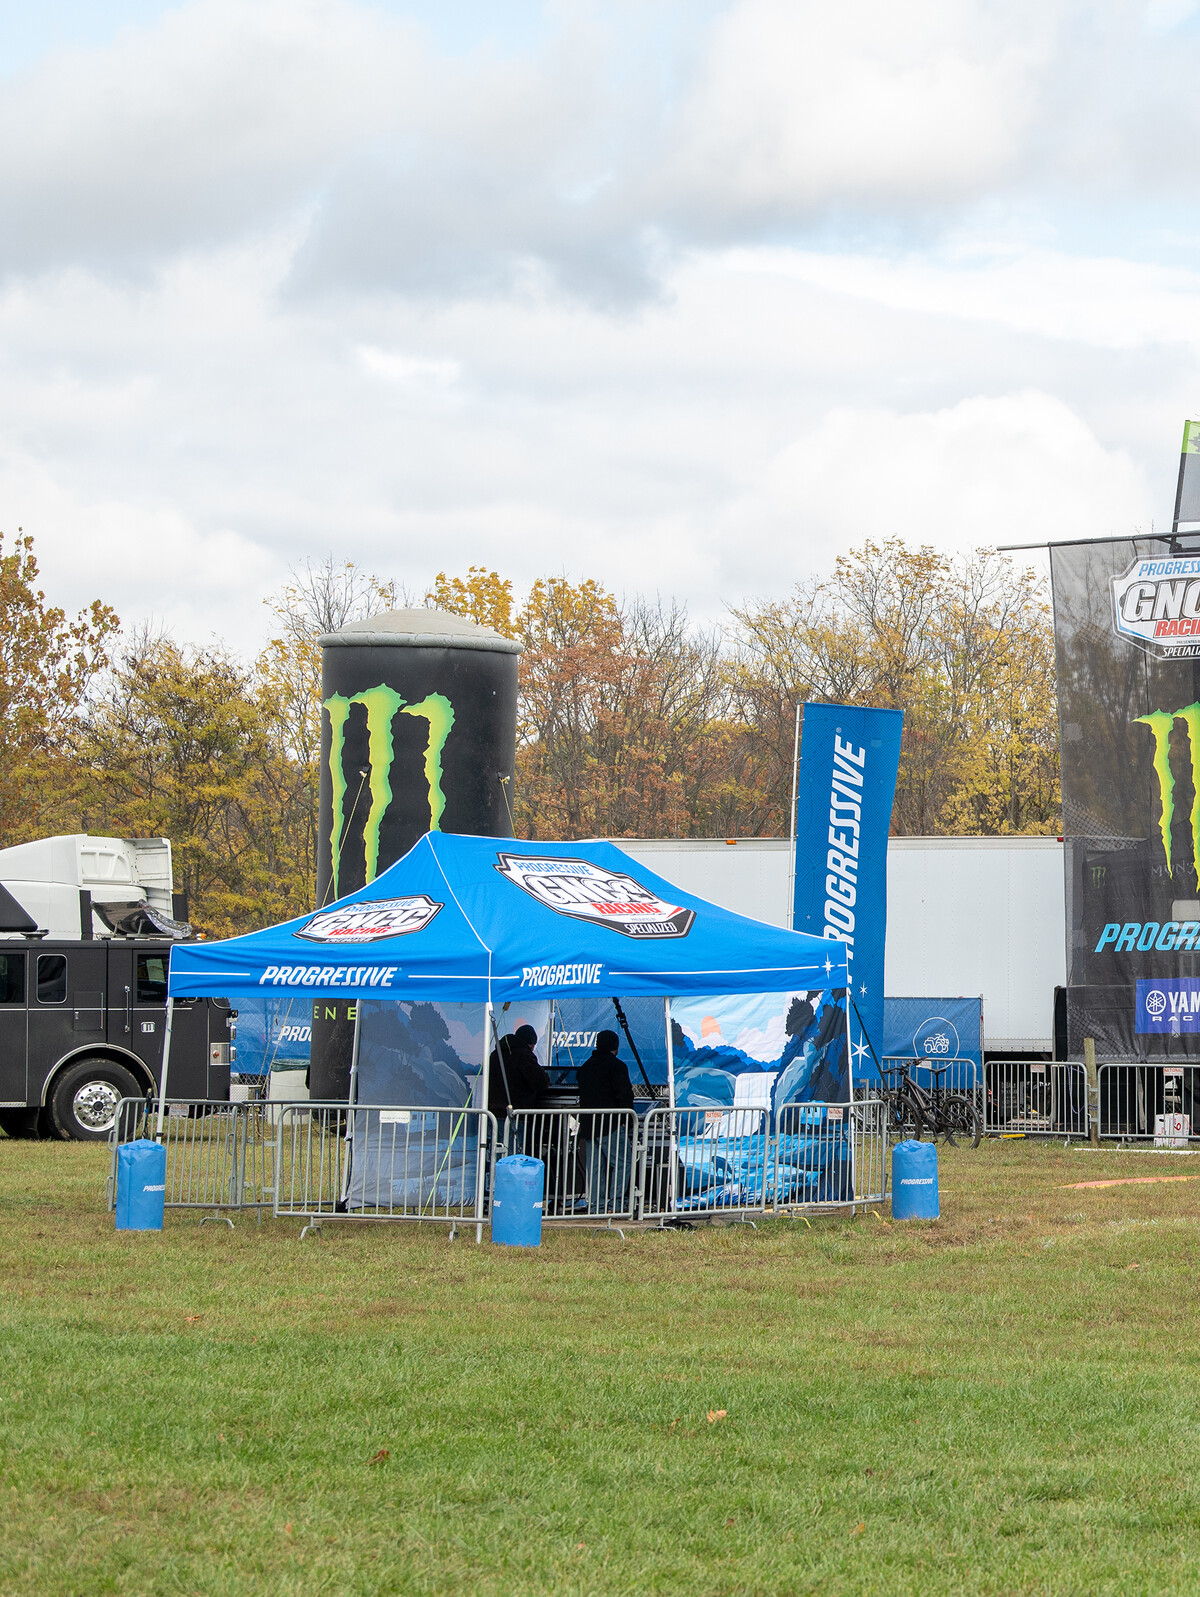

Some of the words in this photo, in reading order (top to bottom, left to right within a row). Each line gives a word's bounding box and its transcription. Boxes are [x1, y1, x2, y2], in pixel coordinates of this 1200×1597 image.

[823, 733, 866, 984] ROGRESSIVE
[512, 860, 595, 876] PROGRESSIVE
[343, 899, 420, 914] PROGRESSIVE
[590, 902, 662, 915] RACING
[308, 906, 432, 932] GNCC
[327, 926, 392, 937] RACING
[623, 921, 678, 935] SPECIALIZED
[258, 965, 399, 988] PROGRESSIVE
[520, 962, 603, 988] PROGRESSIVE
